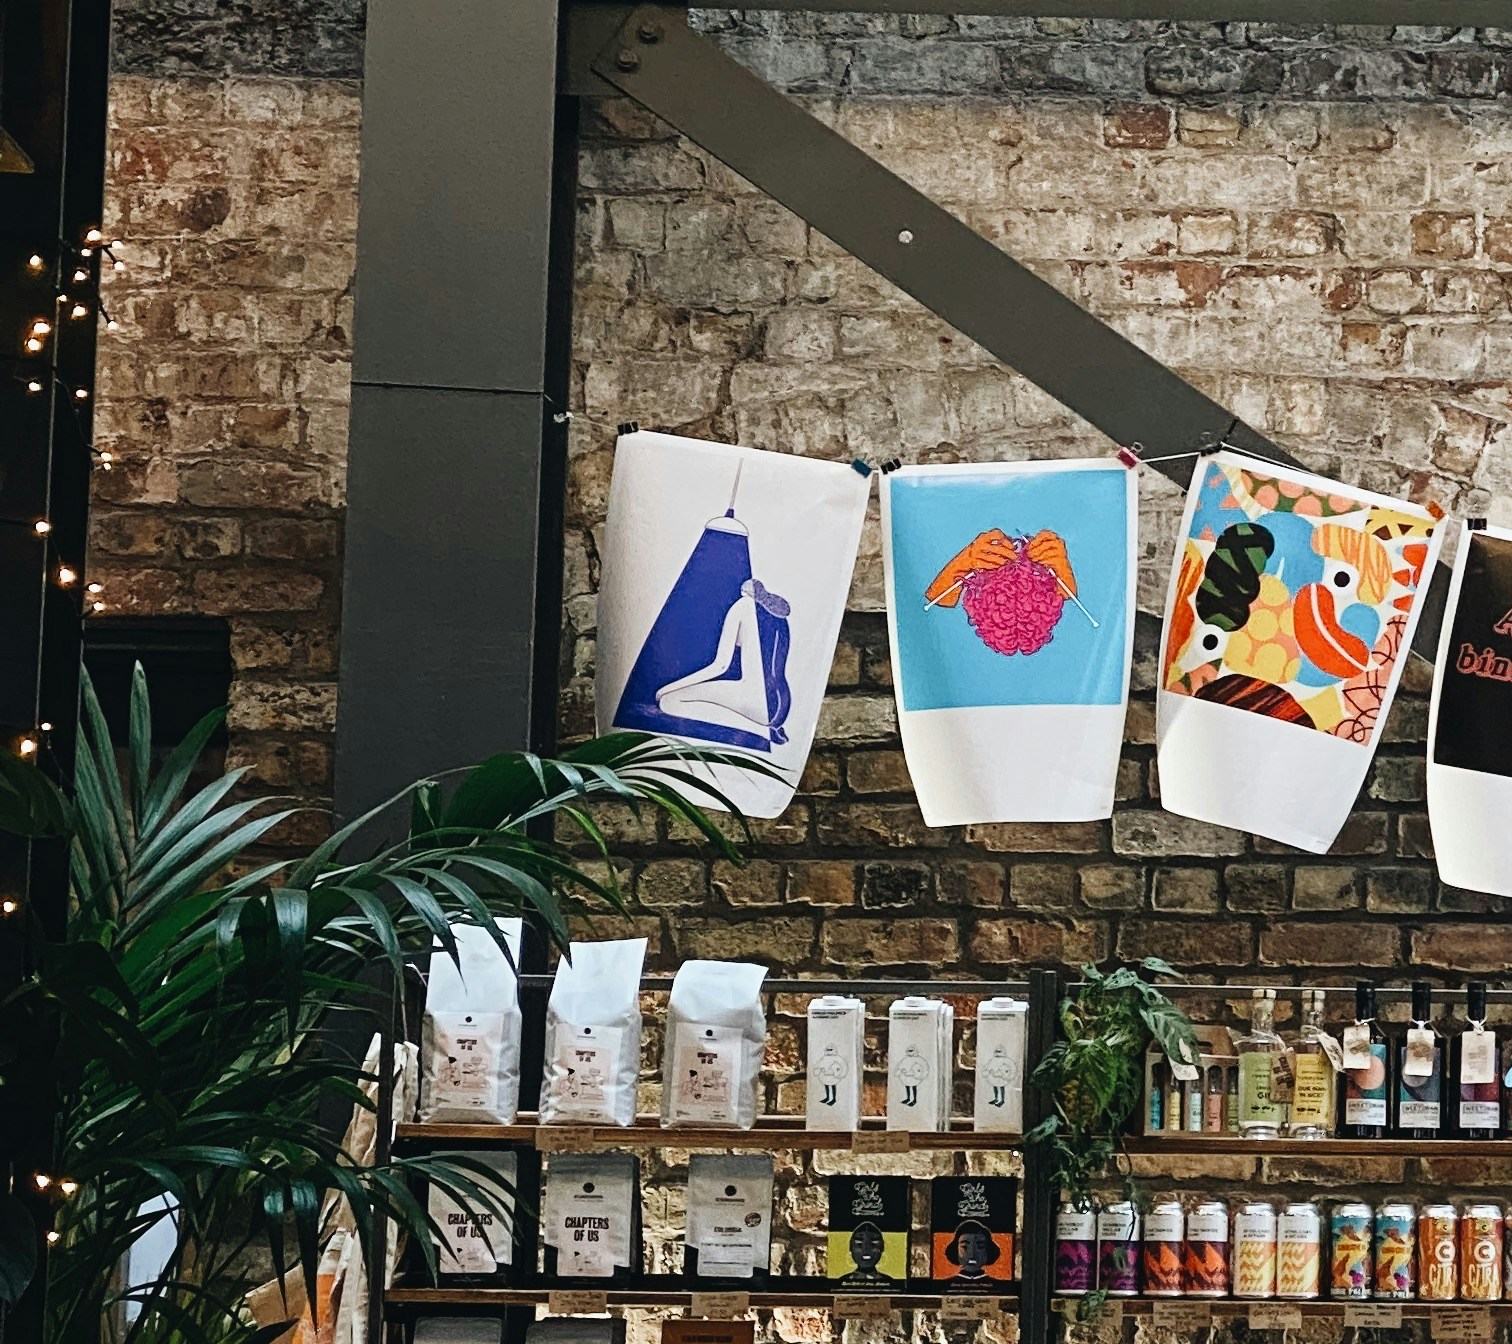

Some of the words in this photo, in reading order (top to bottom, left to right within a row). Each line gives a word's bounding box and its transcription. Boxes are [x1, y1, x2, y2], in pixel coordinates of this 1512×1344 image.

[565, 1216, 609, 1230] CHAPTERS
[457, 1228, 468, 1238] OF
[574, 1230, 585, 1242] OF
[588, 1230, 599, 1242] US
